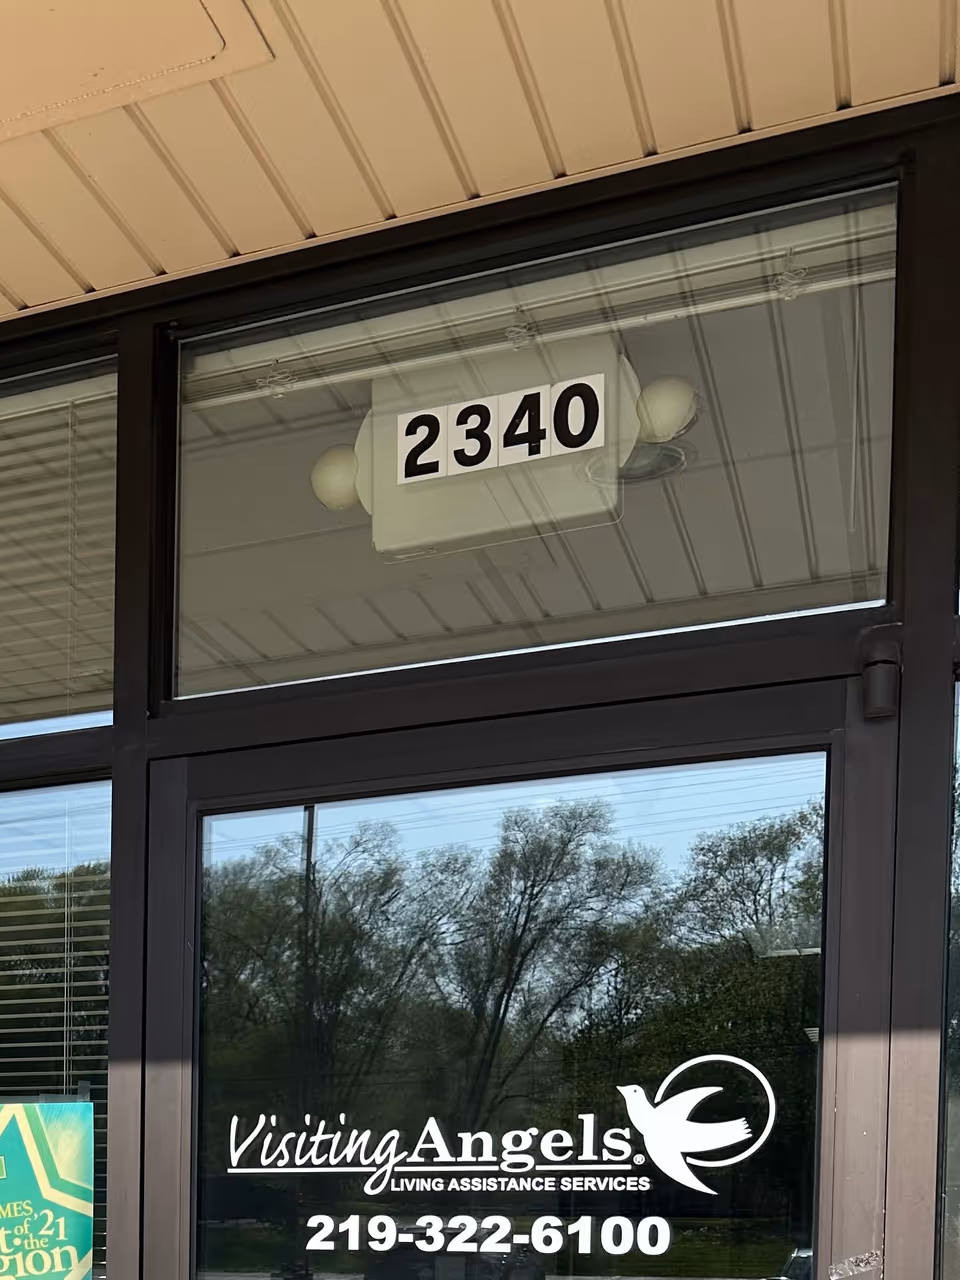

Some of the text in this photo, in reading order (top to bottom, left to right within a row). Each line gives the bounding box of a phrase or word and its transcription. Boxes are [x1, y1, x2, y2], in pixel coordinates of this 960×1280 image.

[404, 382, 600, 479] 2340
[227, 1112, 410, 1196] Visiting
[390, 1176, 651, 1193] LIVING ASSISTANCE SERVICES
[14, 1217, 32, 1236] of
[23, 1232, 49, 1251] the
[305, 1213, 672, 1256] 219-322-6100
